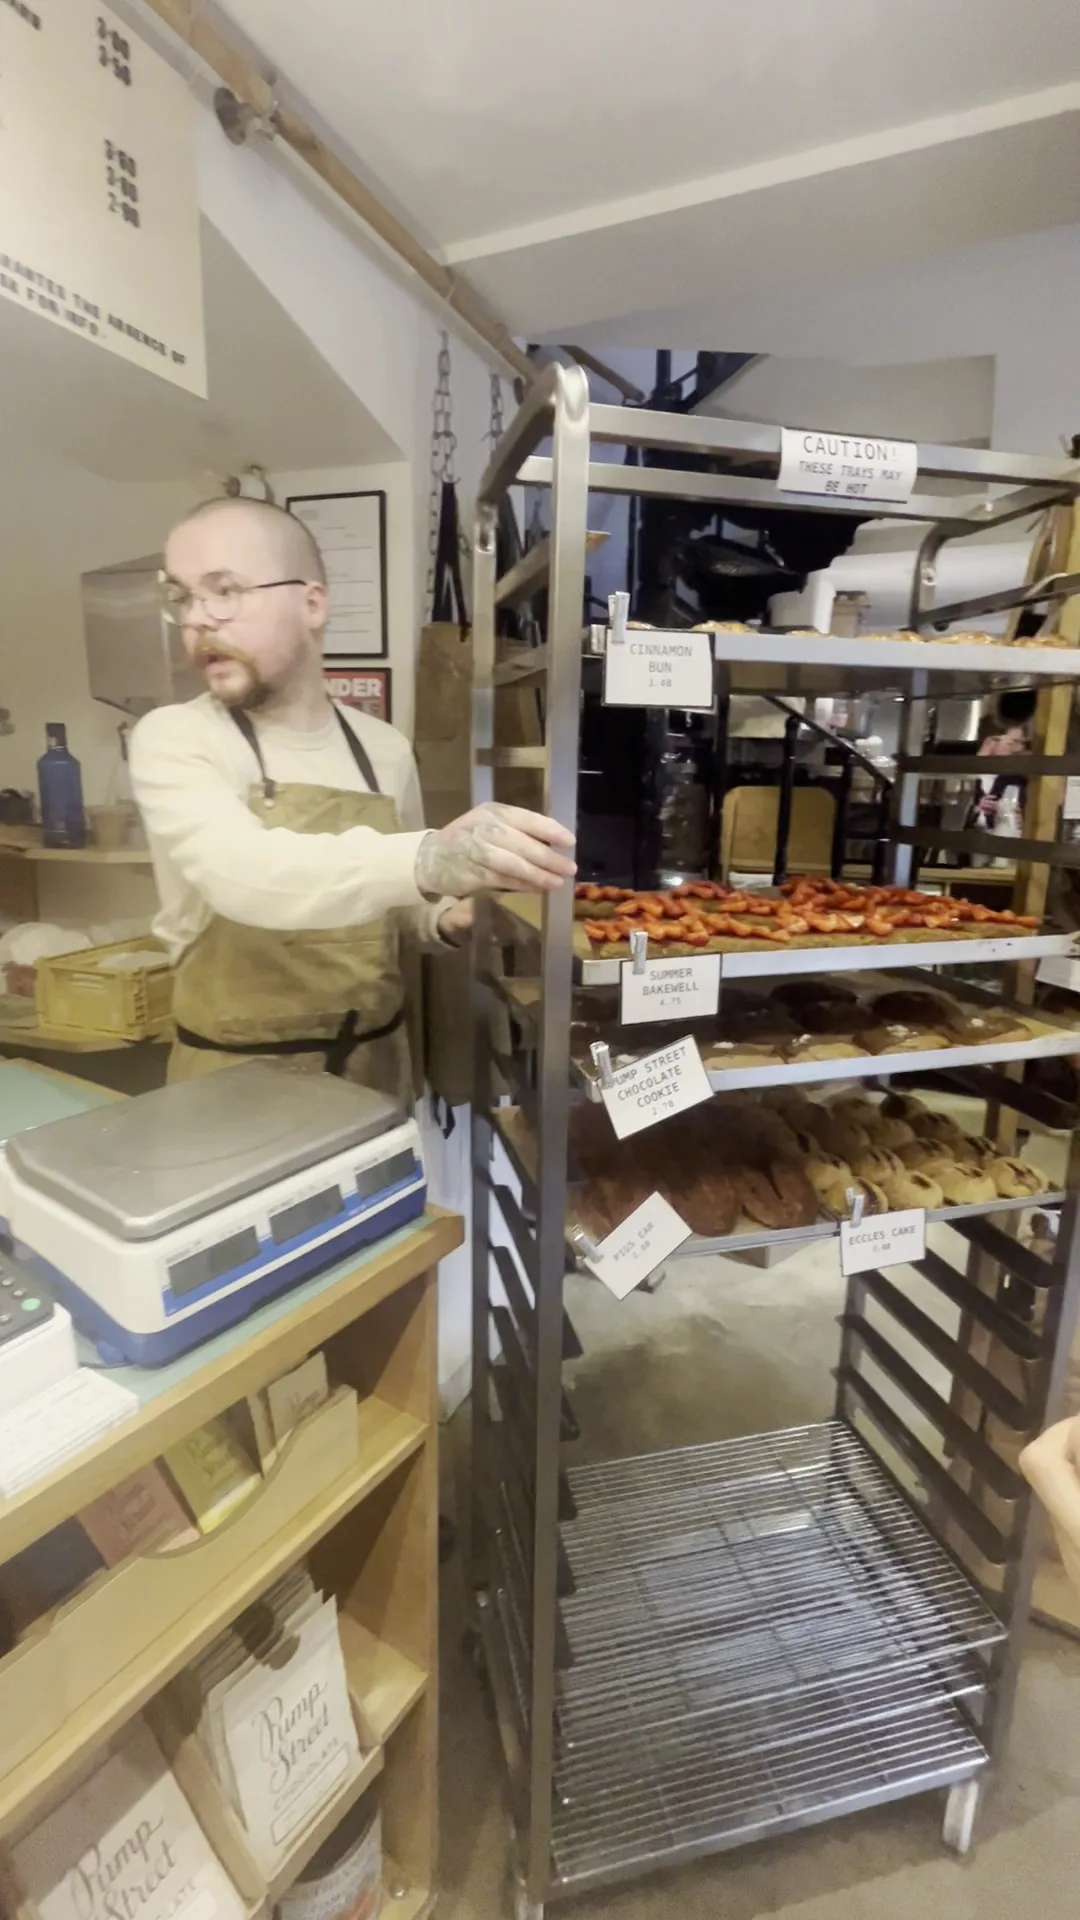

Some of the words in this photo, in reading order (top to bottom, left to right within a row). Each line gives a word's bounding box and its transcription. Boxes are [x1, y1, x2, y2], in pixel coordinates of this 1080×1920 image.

[799, 460, 833, 475] THESE
[841, 465, 874, 479] TRAYS
[880, 470, 902, 481] MAY
[825, 480, 840, 492] BE
[845, 483, 868, 494] HOT
[630, 643, 693, 656] CINNAMON
[648, 661, 672, 673] BUN
[650, 968, 693, 981] SUMMER
[642, 982, 699, 996] BAKEWELL
[647, 1046, 687, 1073] STREET
[617, 1065, 682, 1101] CHOCOLATE
[637, 1082, 680, 1108] COOKIE
[849, 1231, 885, 1245] ECCLES
[892, 1225, 916, 1237] CAKE
[252, 1680, 328, 1763] Pump
[269, 1702, 329, 1794] Street
[71, 1816, 164, 1920] Pump
